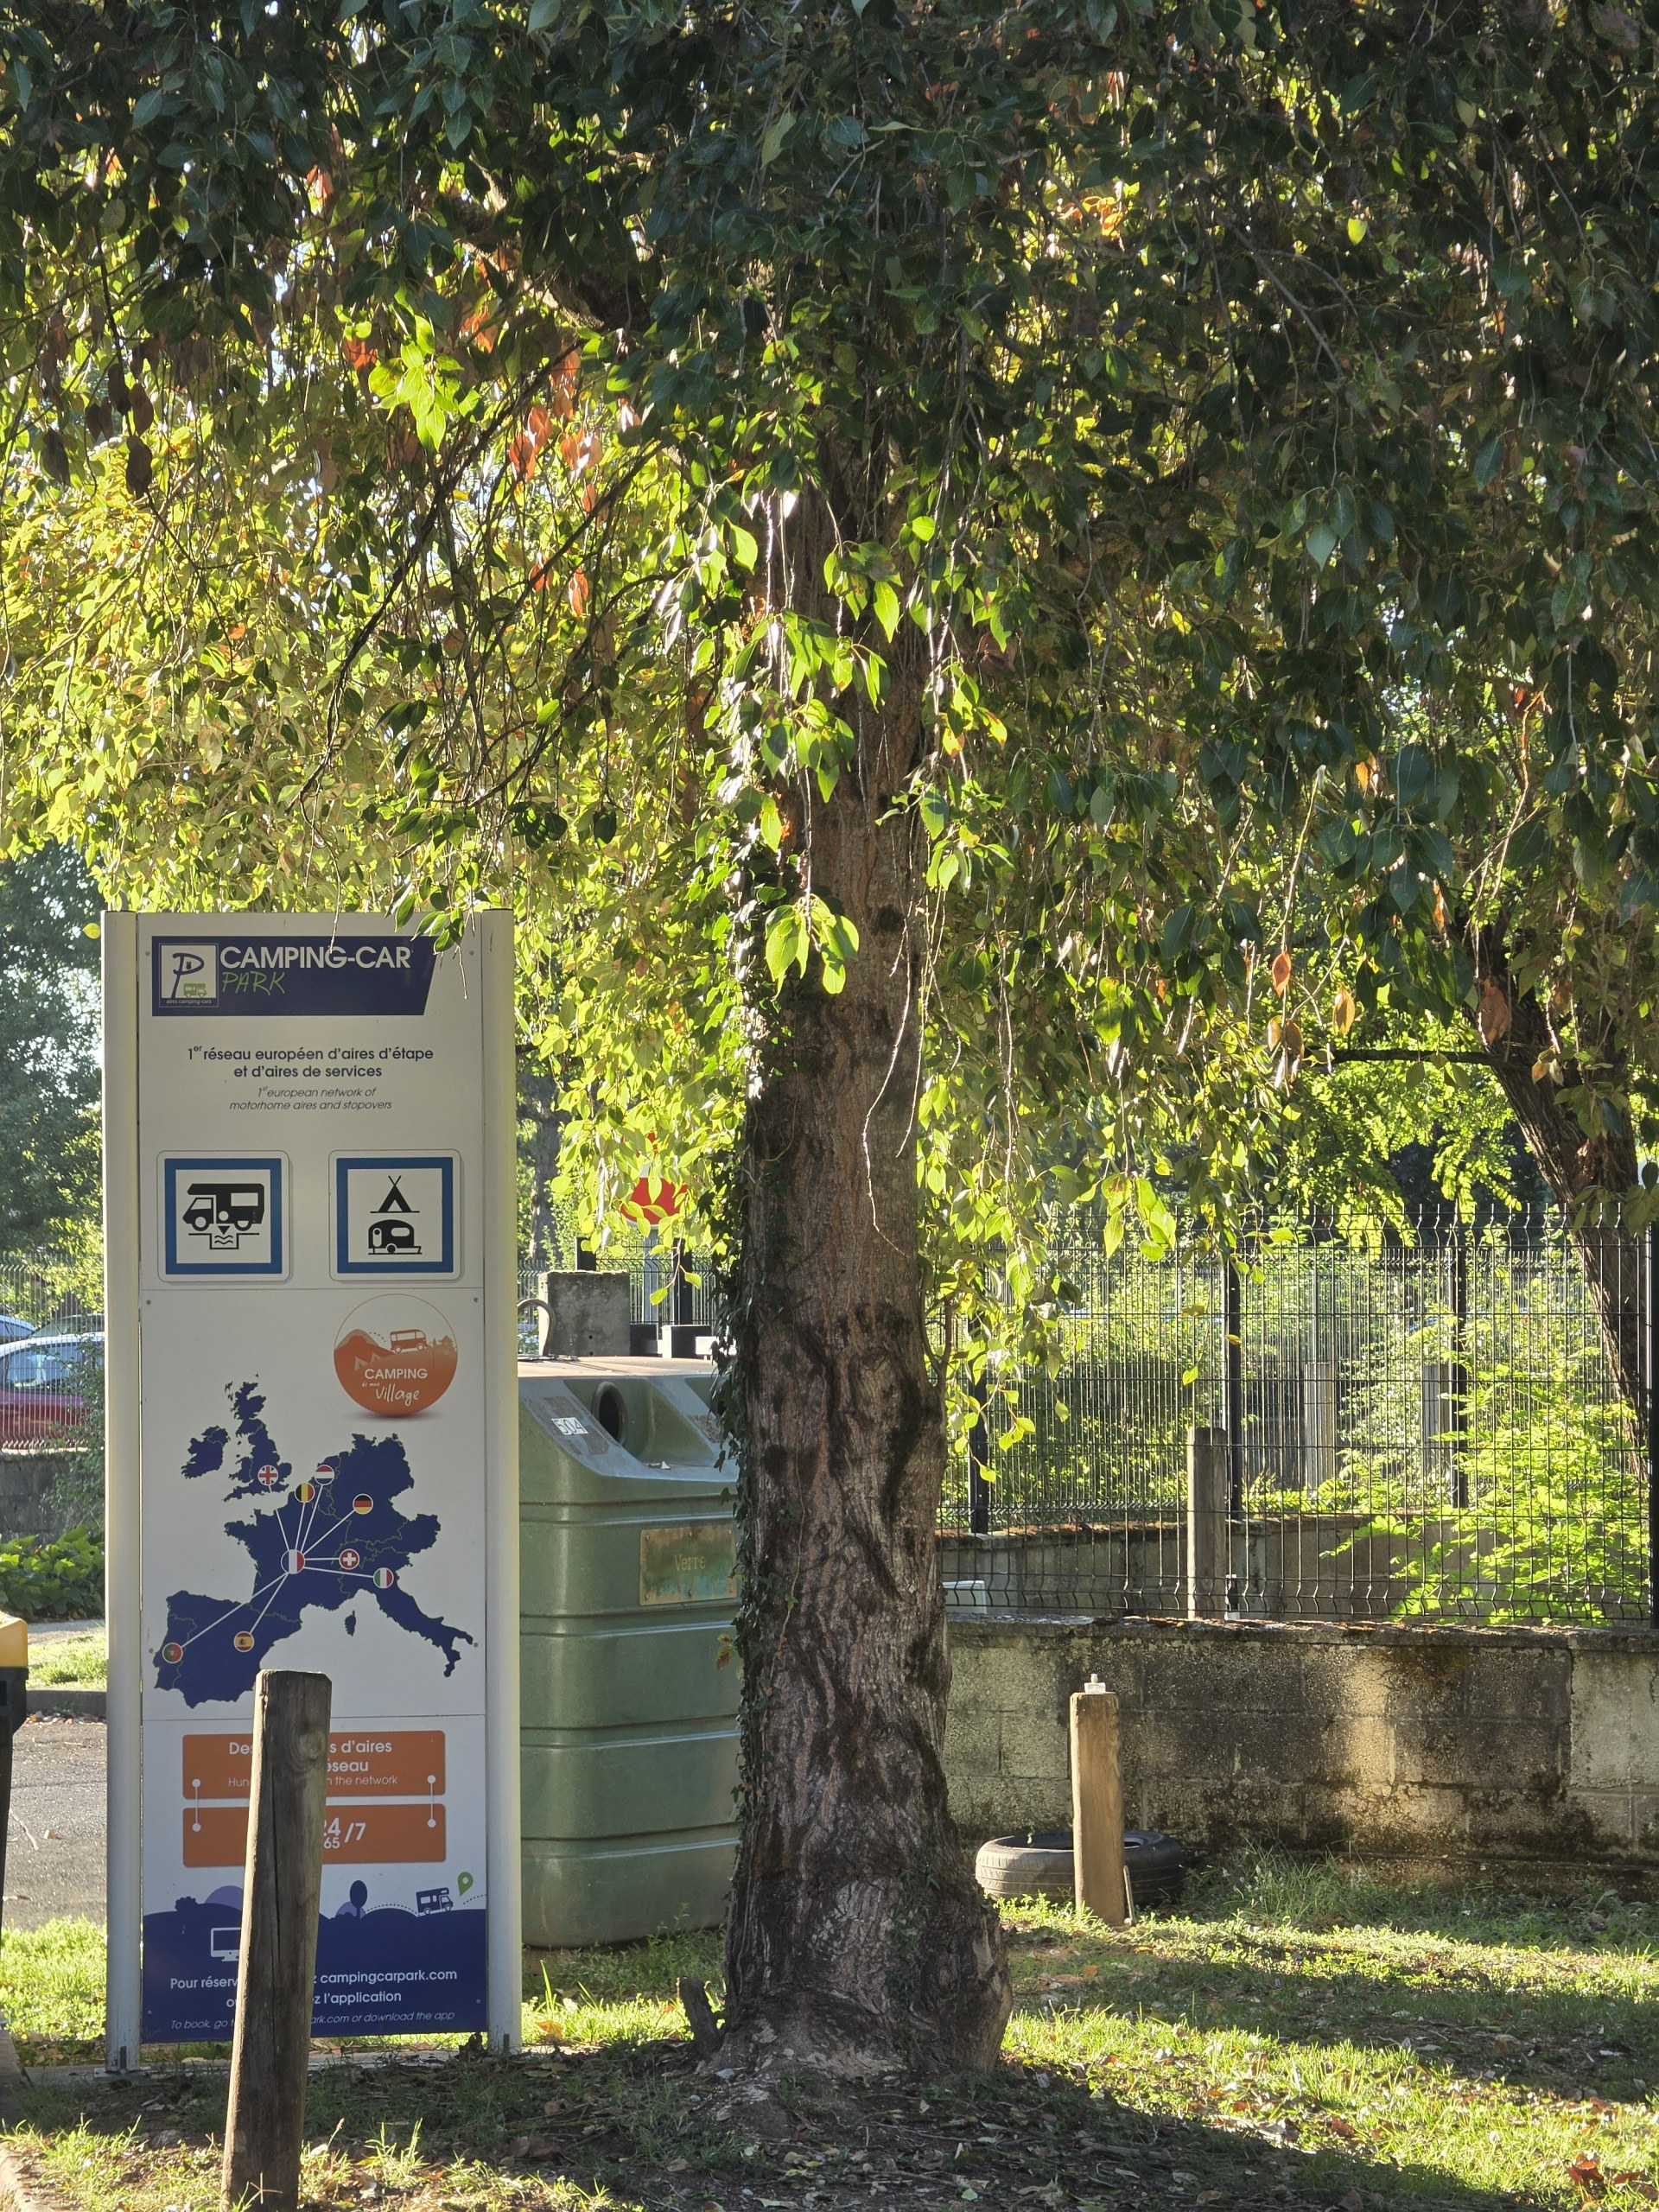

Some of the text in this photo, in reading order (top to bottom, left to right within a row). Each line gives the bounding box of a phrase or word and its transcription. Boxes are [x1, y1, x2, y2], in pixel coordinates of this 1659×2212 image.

[219, 946, 411, 969] CAMPING-CAR
[221, 971, 286, 996] PARK
[203, 1047, 251, 1060] réseau
[255, 1047, 324, 1062] européen
[327, 1047, 375, 1060] d'aires
[378, 1046, 434, 1062] d'étape
[233, 1065, 383, 1077] et d'aires de services
[267, 1089, 319, 1099] european
[321, 1087, 363, 1097] network
[365, 1087, 378, 1097] of
[229, 1101, 393, 1111] motorhome aires and stopovers
[365, 1368, 429, 1380] CAMPING
[674, 1554, 707, 1572] Verre
[340, 1739, 393, 1753] d'aires
[335, 1776, 353, 1786] the
[355, 1775, 398, 1786] network
[323, 1837, 340, 1849] 65
[320, 1969, 458, 1985] campingcarpark.com
[170, 1978, 198, 1989] Pour
[323, 1991, 402, 2006] l'application
[351, 2015, 363, 2024] or
[363, 2012, 415, 2023] download
[416, 2011, 433, 2021] the
[434, 2012, 456, 2023] app
[172, 2020, 182, 2030] To
[213, 2019, 228, 2030] go
